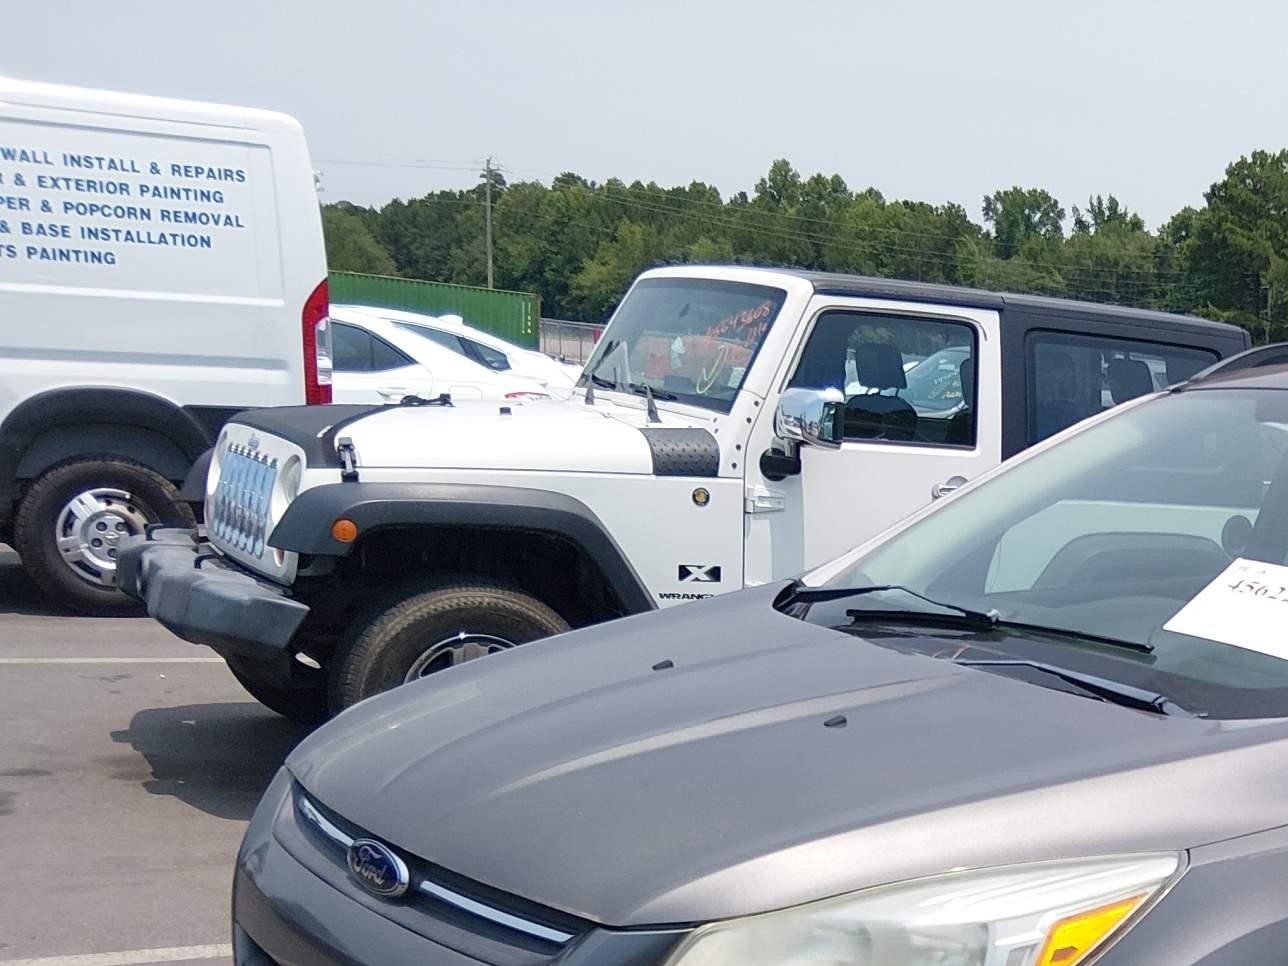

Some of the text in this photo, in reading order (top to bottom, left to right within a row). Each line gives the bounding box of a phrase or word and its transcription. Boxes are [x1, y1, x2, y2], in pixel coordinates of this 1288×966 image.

[63, 154, 140, 173] INSTALL
[150, 162, 160, 174] &
[171, 164, 245, 182] REPAIRS
[14, 173, 25, 186] &
[37, 176, 130, 195] EXTERIOR
[139, 184, 223, 203] PAINTING
[40, 200, 52, 212] &
[63, 202, 151, 220] POPCORN
[160, 210, 244, 228] REMOVAL
[0, 220, 211, 248] & BASE INSTALLATION
[27, 246, 115, 265] PAINTING
